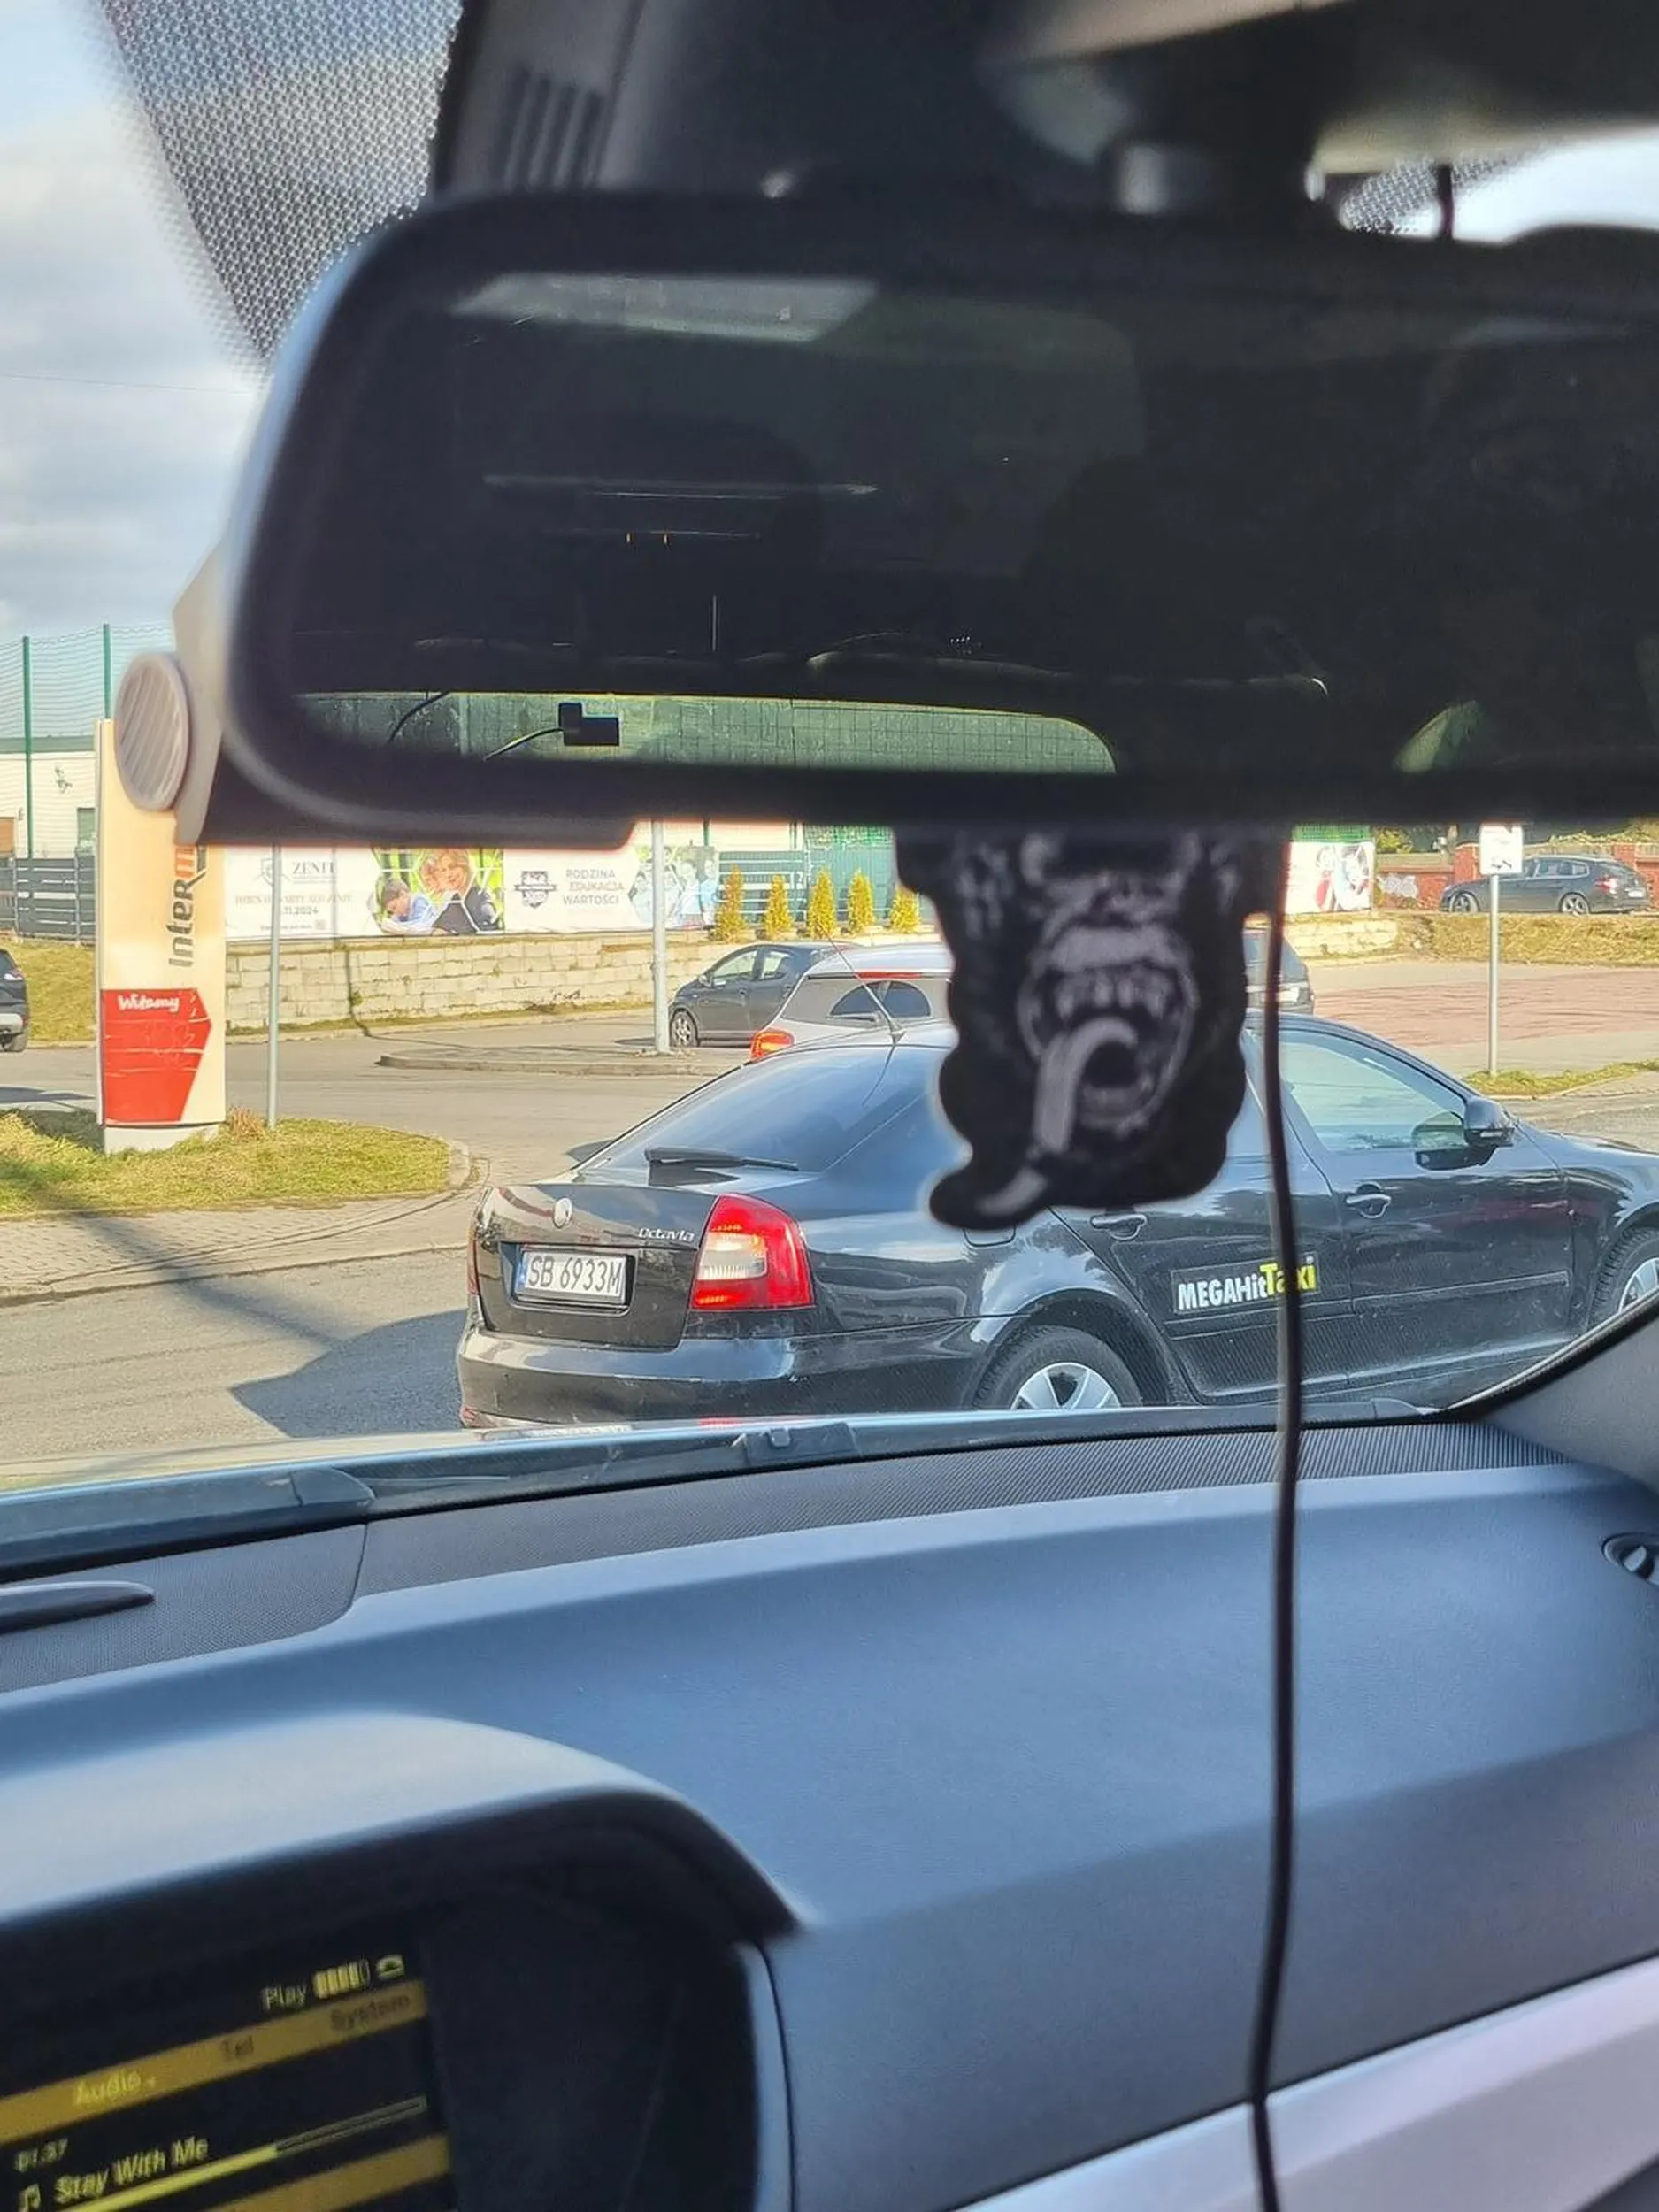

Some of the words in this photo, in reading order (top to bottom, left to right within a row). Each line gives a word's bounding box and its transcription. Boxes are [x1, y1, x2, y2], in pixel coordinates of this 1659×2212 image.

[565, 869, 616, 879] RODZINA
[563, 894, 619, 905] WARTOŚCI
[638, 1227, 695, 1241] Octavia
[528, 1255, 554, 1287] SB
[560, 1256, 621, 1295] 6933M
[262, 1985, 307, 2011] Play
[330, 1994, 411, 2032] System
[54, 2167, 110, 2203] Stay
[111, 2147, 166, 2185] With
[172, 2135, 209, 2166] Me
